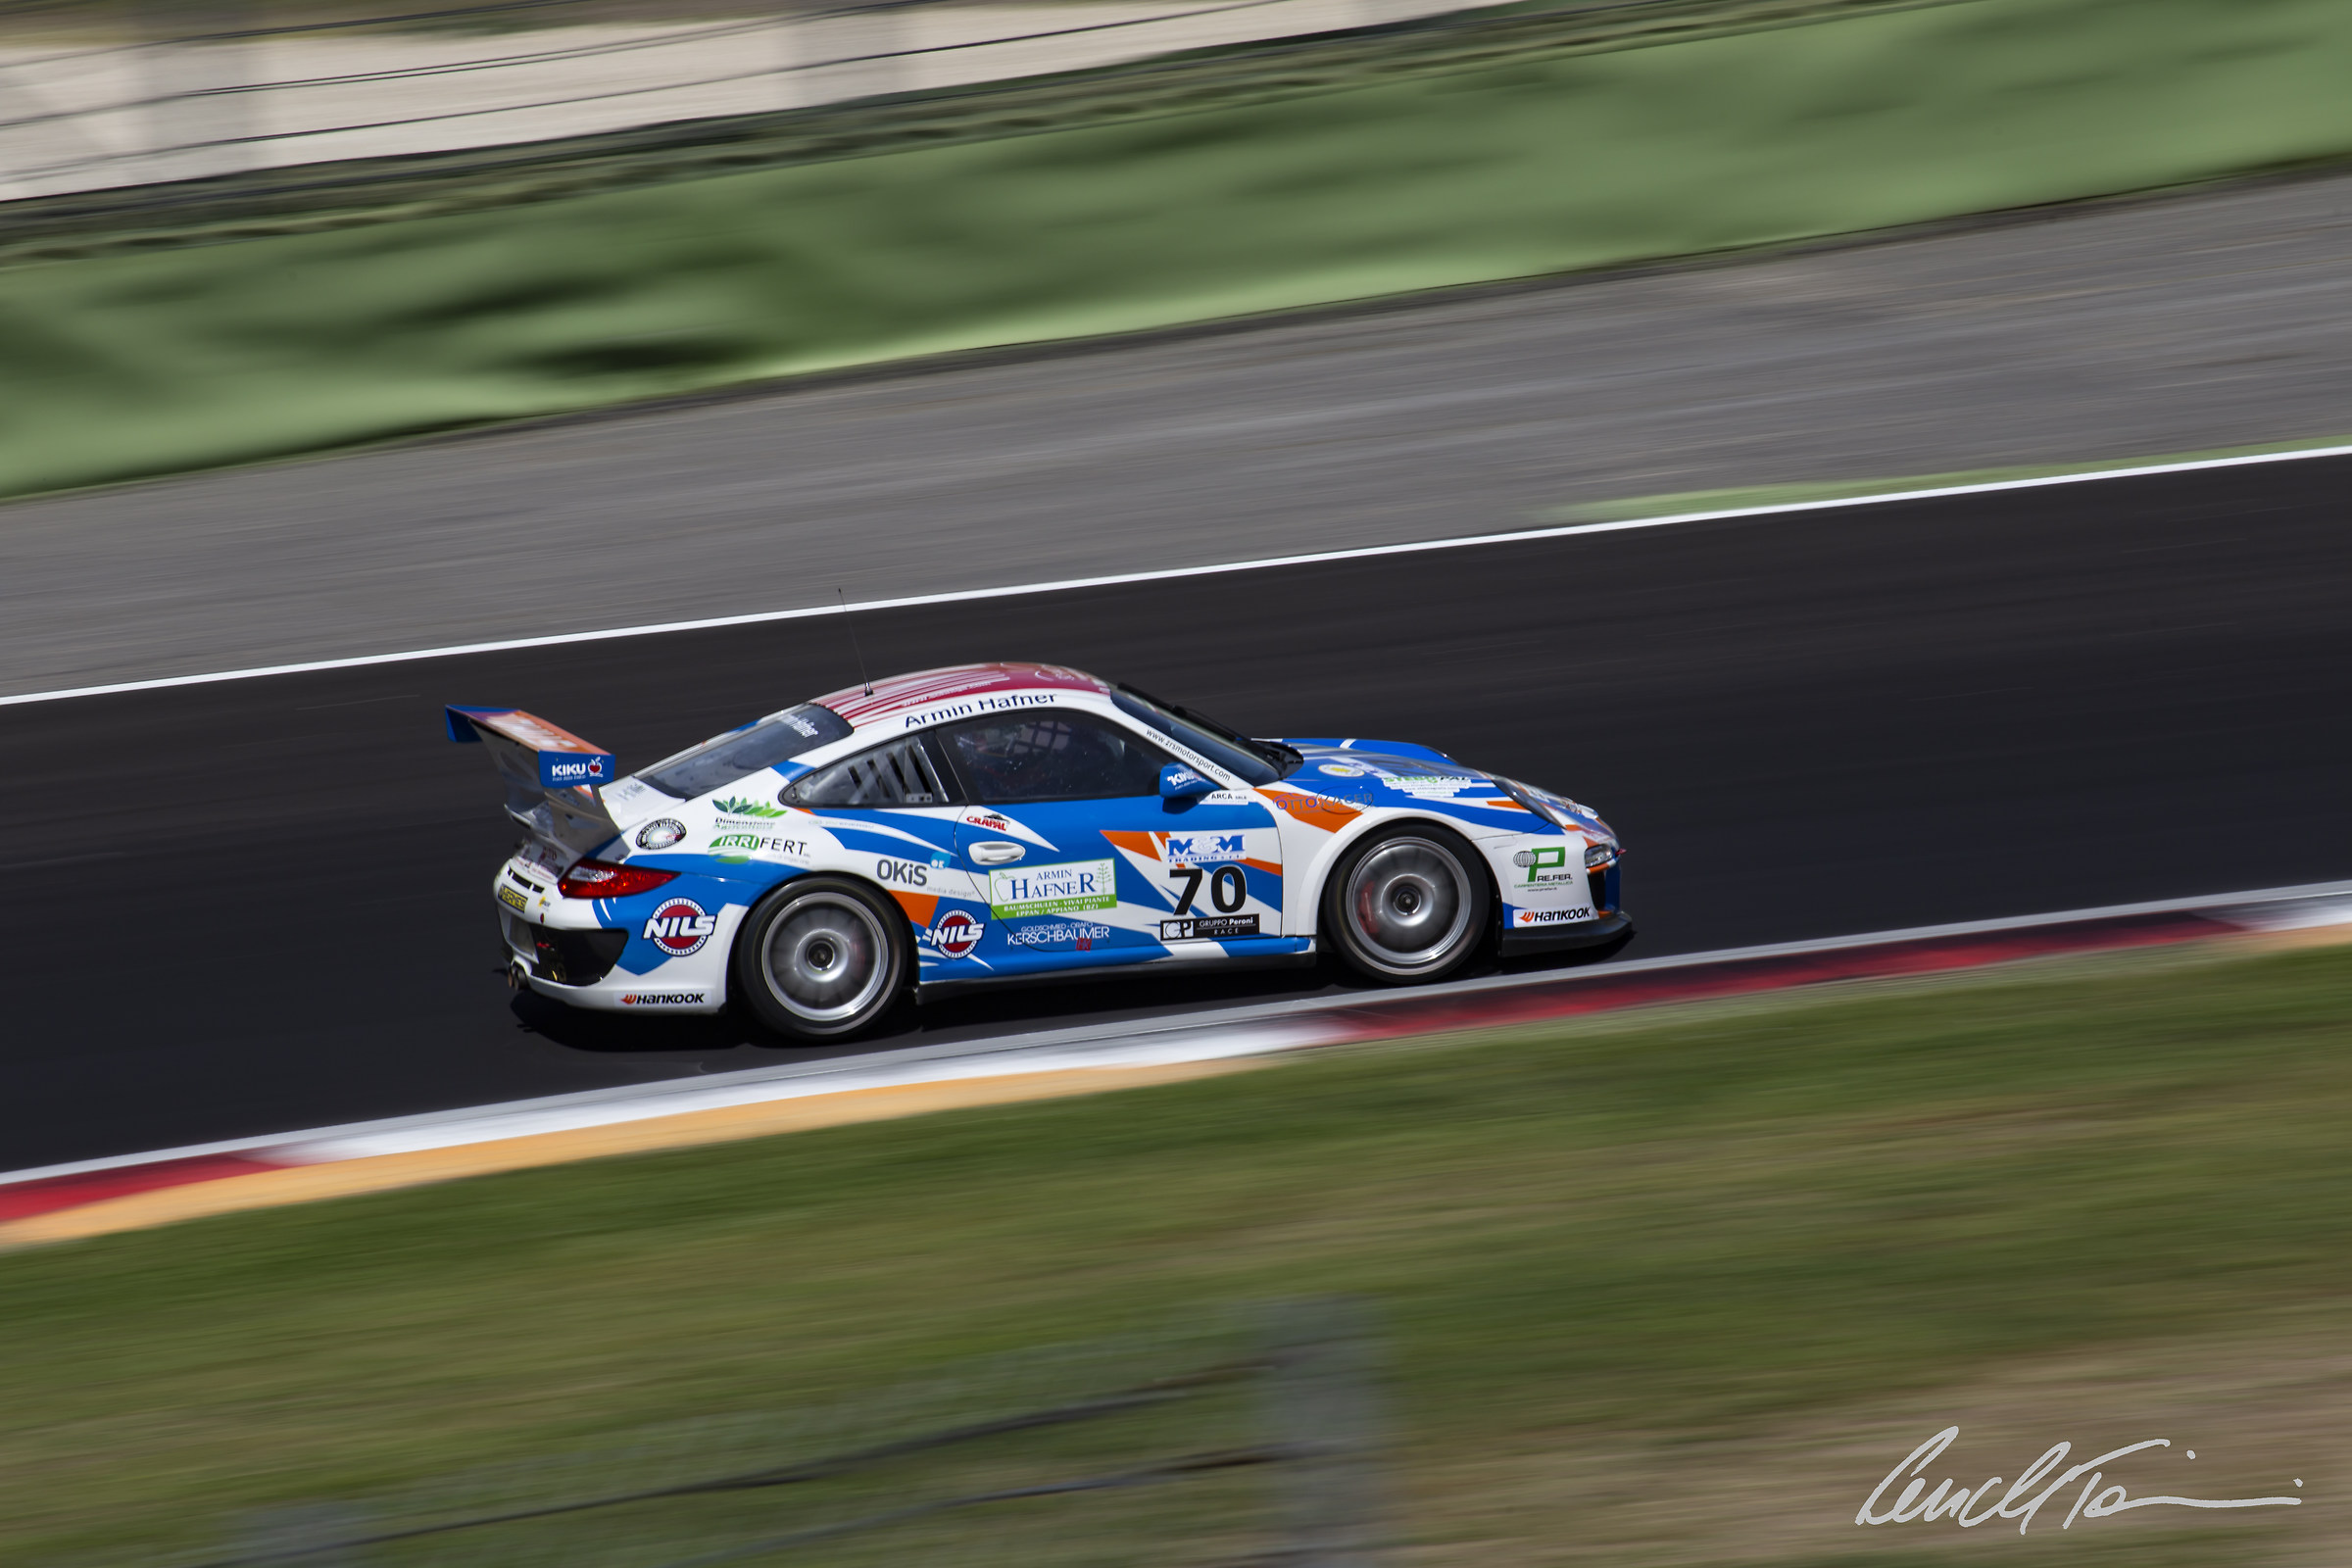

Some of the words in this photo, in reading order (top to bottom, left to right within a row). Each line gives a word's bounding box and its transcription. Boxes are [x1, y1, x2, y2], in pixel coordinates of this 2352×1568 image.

[905, 703, 973, 728] Armin
[978, 694, 1057, 710] Hafner
[552, 763, 586, 776] KIKU
[1276, 797, 1317, 809] OTTO
[1037, 869, 1072, 880] ARMIN
[1010, 872, 1097, 900] HAFNER
[1169, 864, 1247, 915] 70
[1004, 901, 1058, 911] BAUMSCHULEN
[643, 915, 716, 938] NILS
[1199, 918, 1228, 927] GRUPPO
[1229, 917, 1253, 926] Peroni
[932, 924, 984, 946] NILS
[1006, 926, 1110, 946] KERSCHBAUMER
